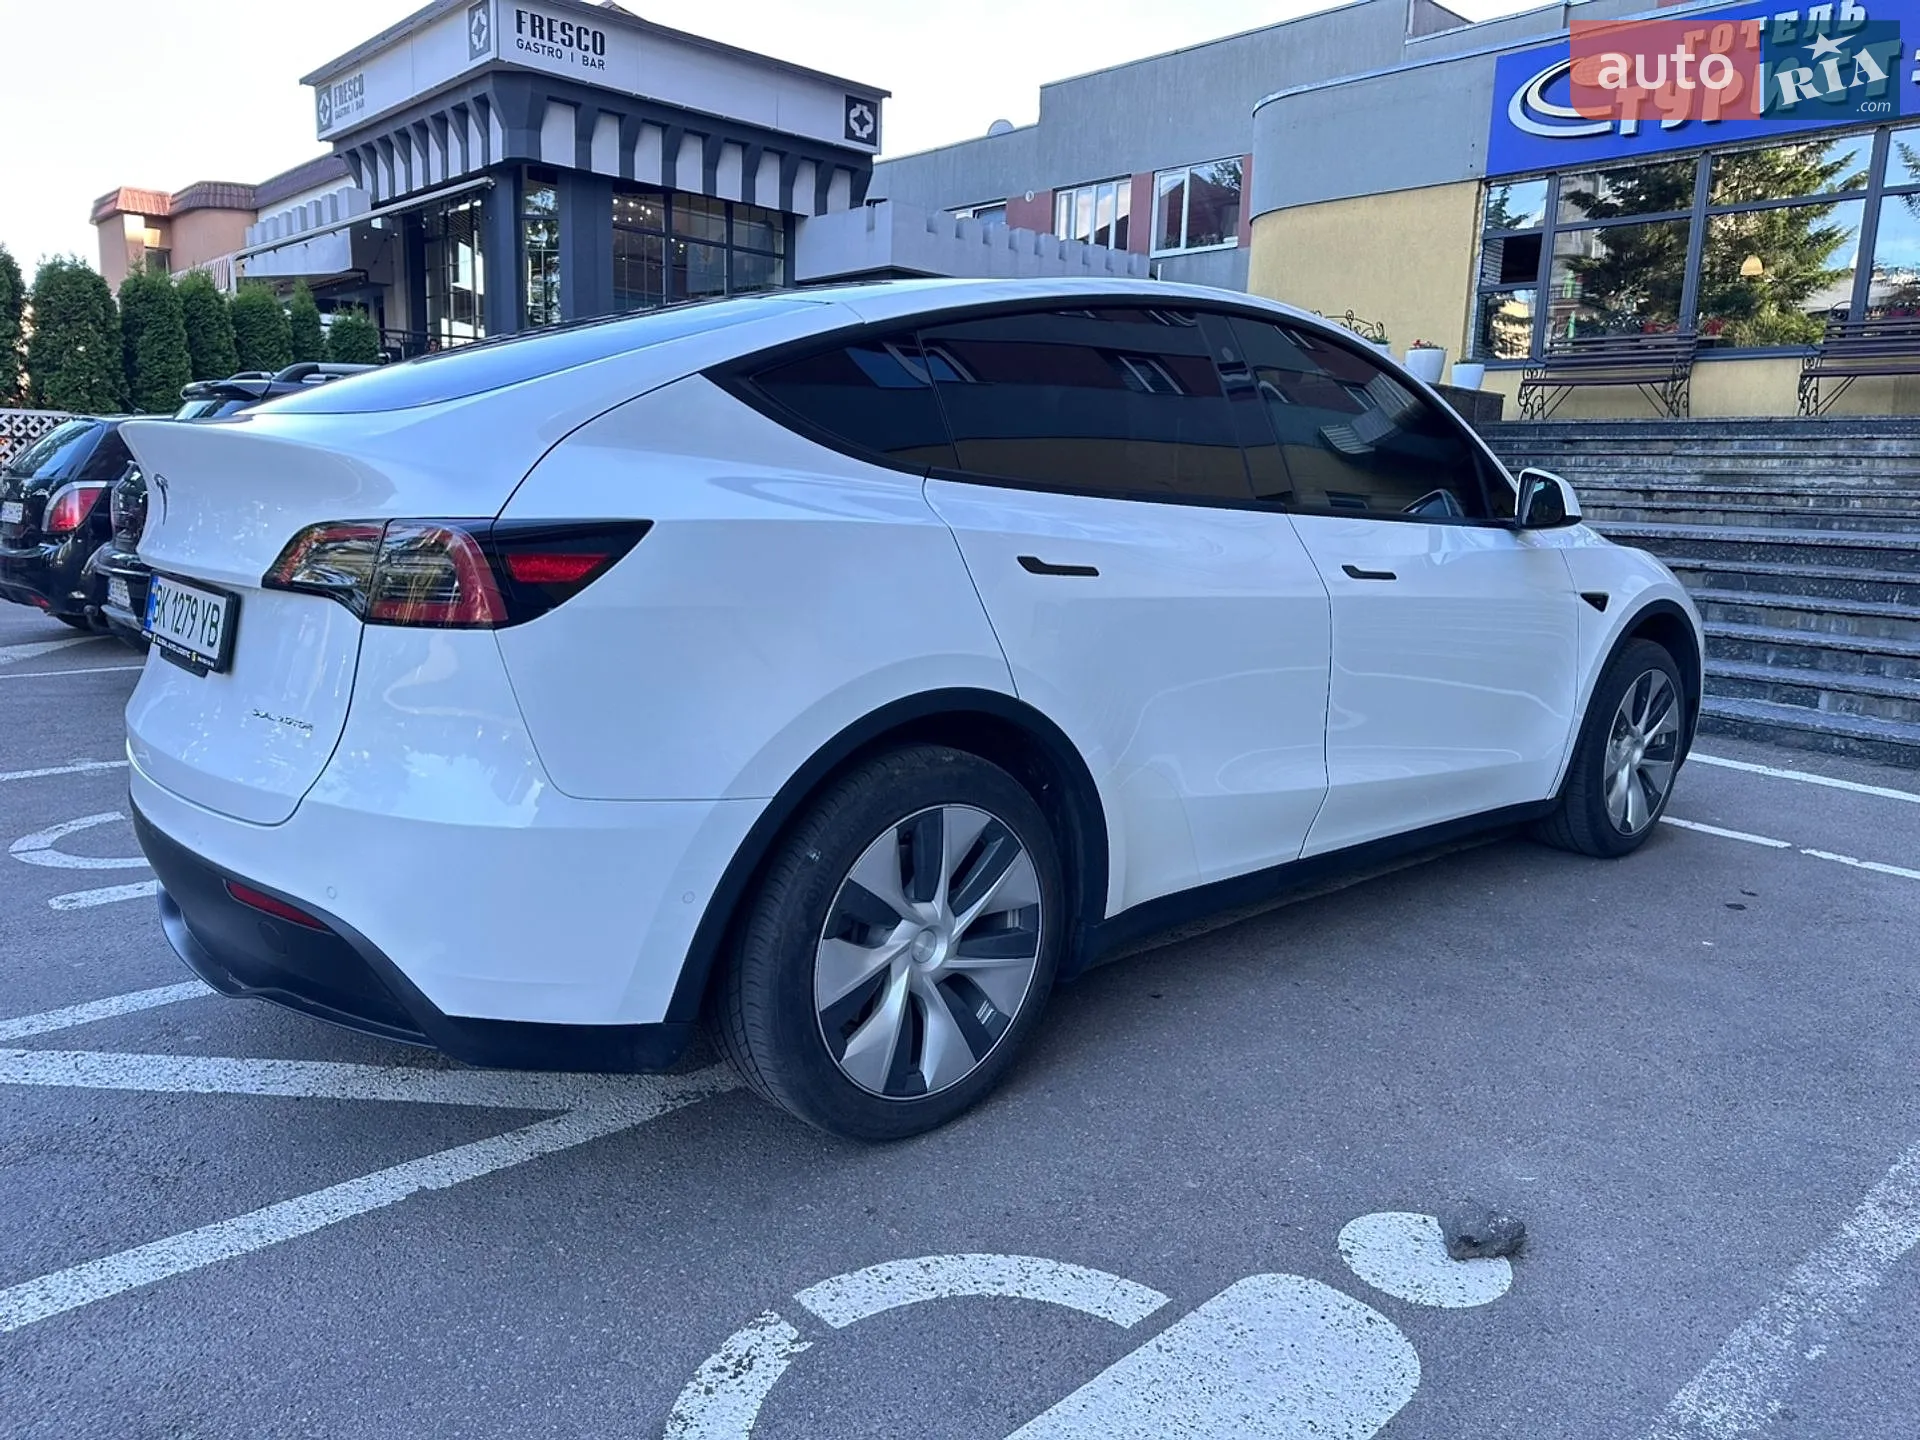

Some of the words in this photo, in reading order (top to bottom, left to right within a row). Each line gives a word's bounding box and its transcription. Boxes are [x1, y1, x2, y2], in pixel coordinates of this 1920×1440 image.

[515, 9, 605, 56] FRESCO
[1683, 0, 1867, 54] ГОТЕЛЬ
[516, 38, 563, 60] GASTRO
[581, 55, 605, 71] BAR
[333, 73, 364, 108] FRESCO
[152, 585, 171, 628] BK
[171, 591, 199, 639] 1279
[200, 600, 220, 648] YB
